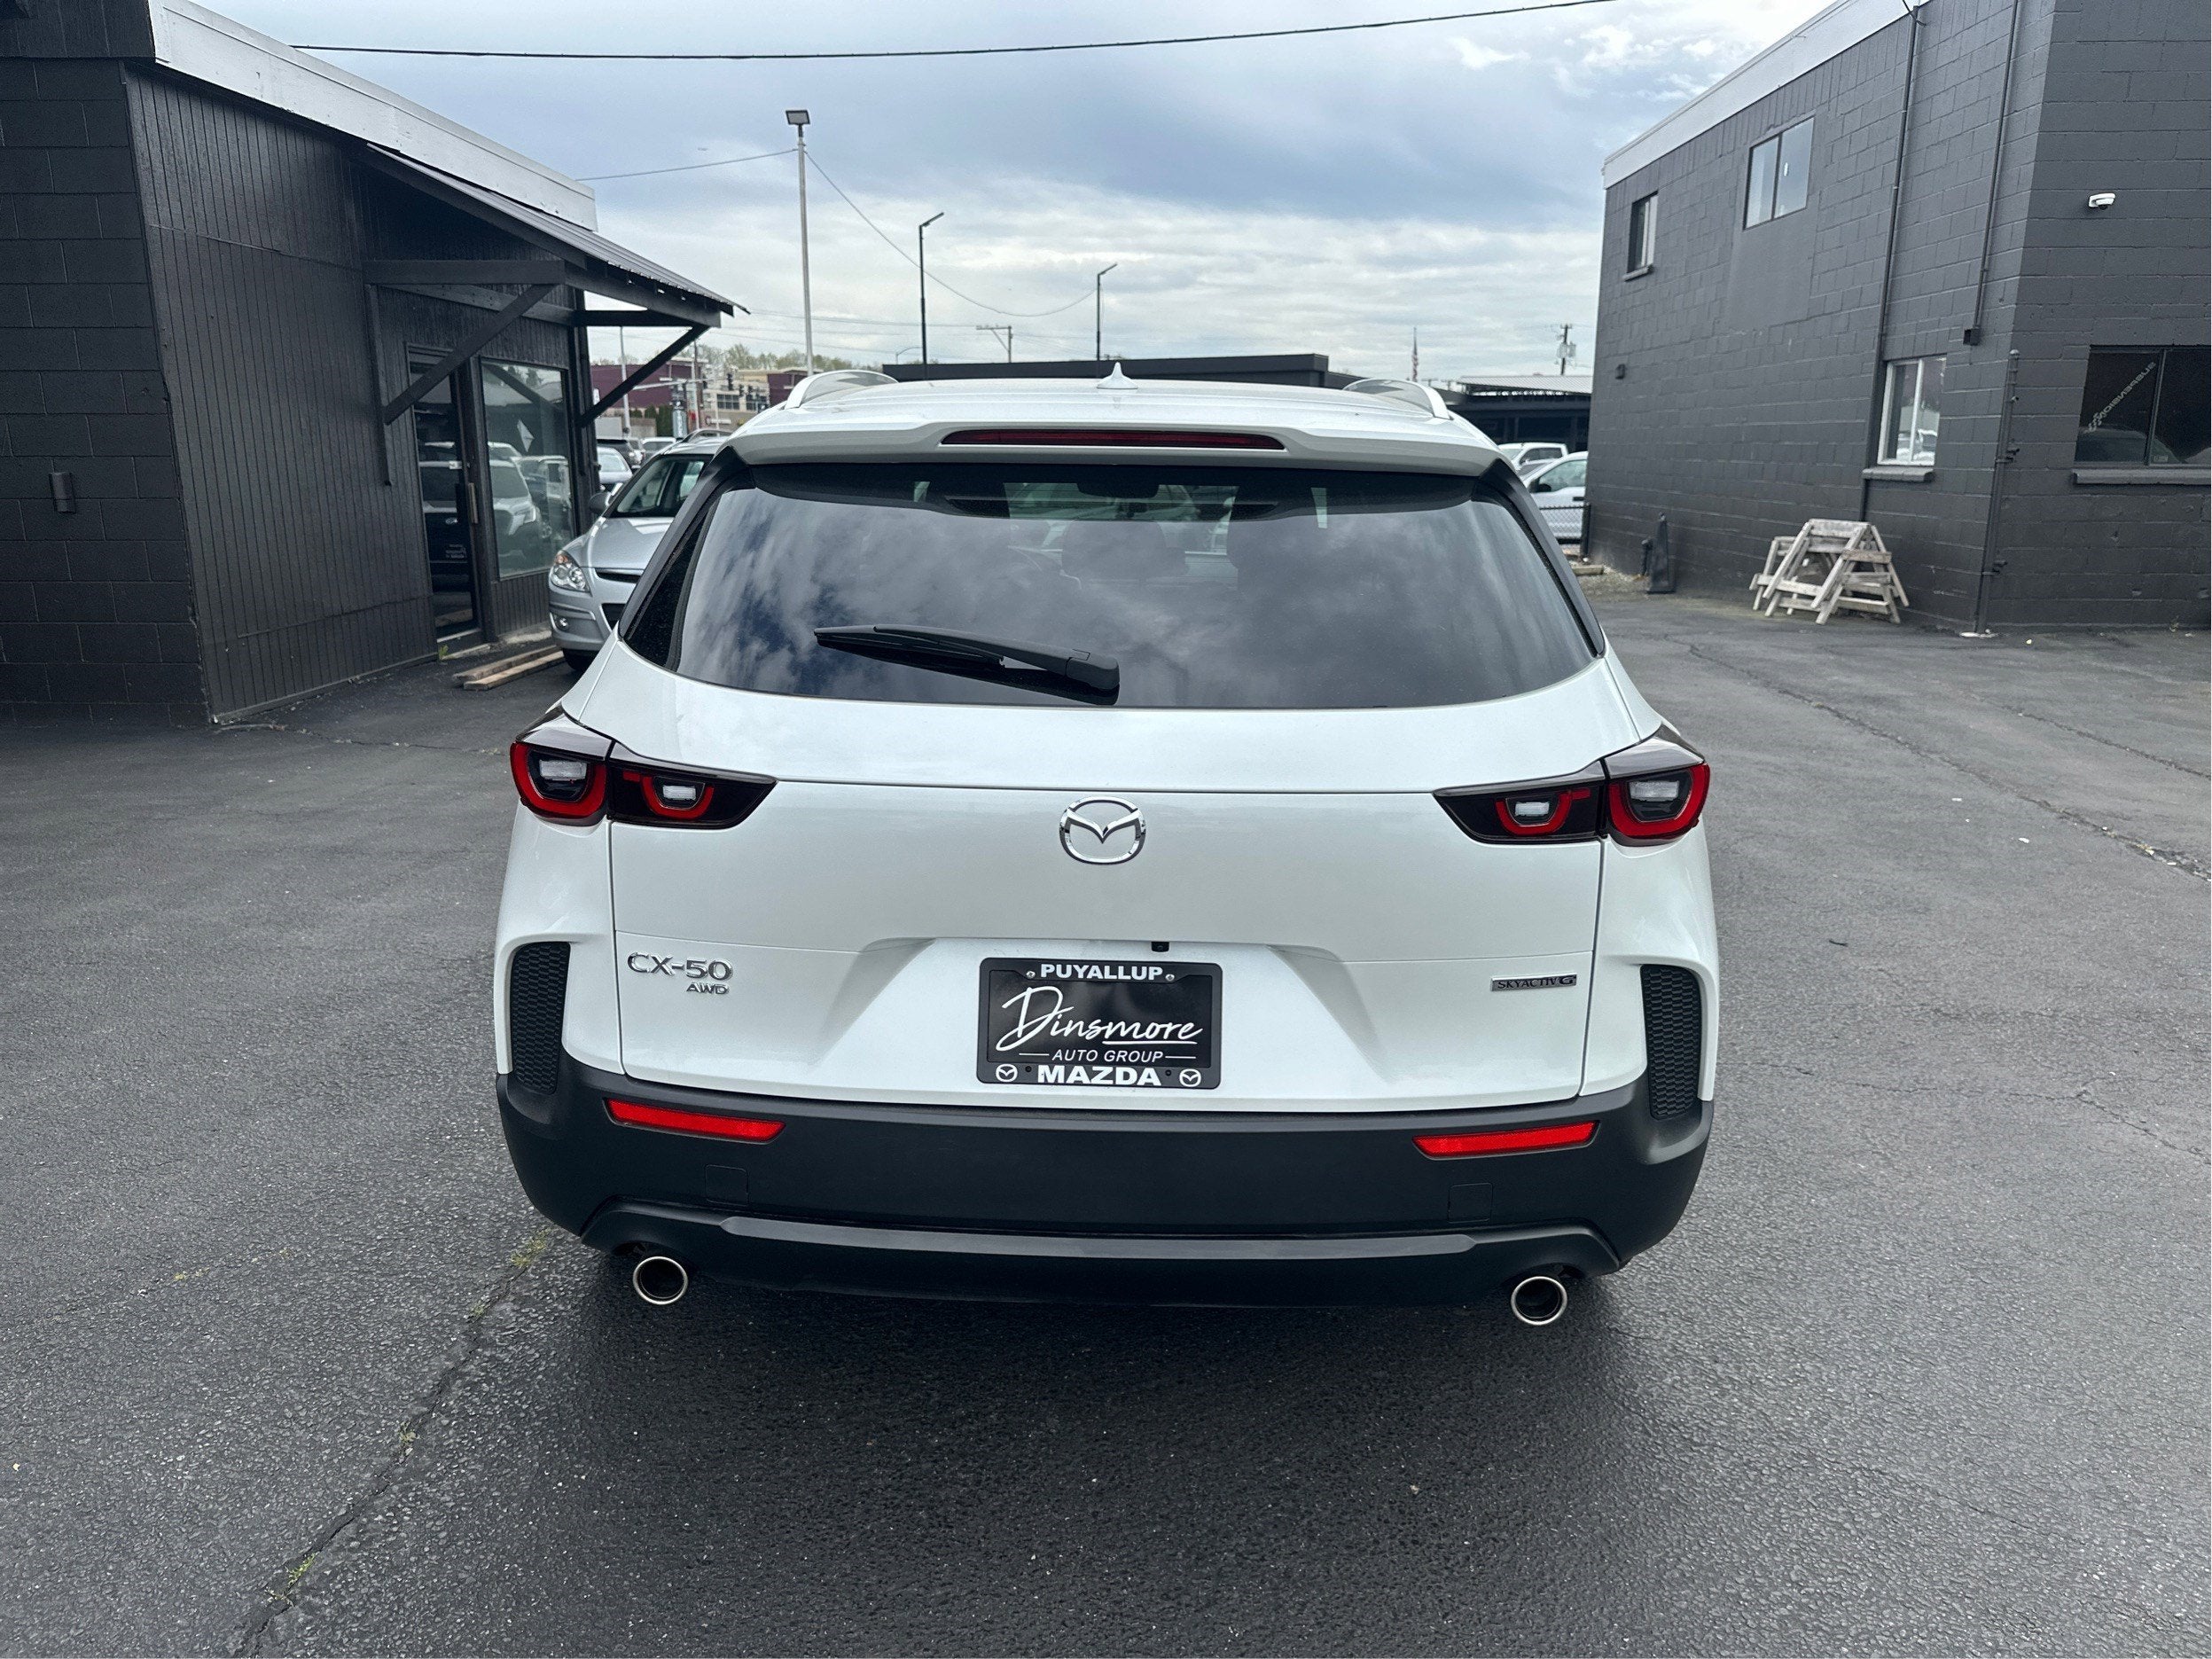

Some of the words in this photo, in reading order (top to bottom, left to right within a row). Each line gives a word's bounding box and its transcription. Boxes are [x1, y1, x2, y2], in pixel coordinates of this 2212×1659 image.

[627, 951, 733, 981] CX-50
[1041, 964, 1163, 980] PUYALLUP
[686, 982, 729, 995] AWD
[1497, 977, 1558, 989] SKYACTIV
[996, 985, 1203, 1051] Dinsmore
[1051, 1049, 1099, 1062] AUTO
[1105, 1050, 1163, 1063] GROUP
[1037, 1064, 1161, 1086] MAZDA
